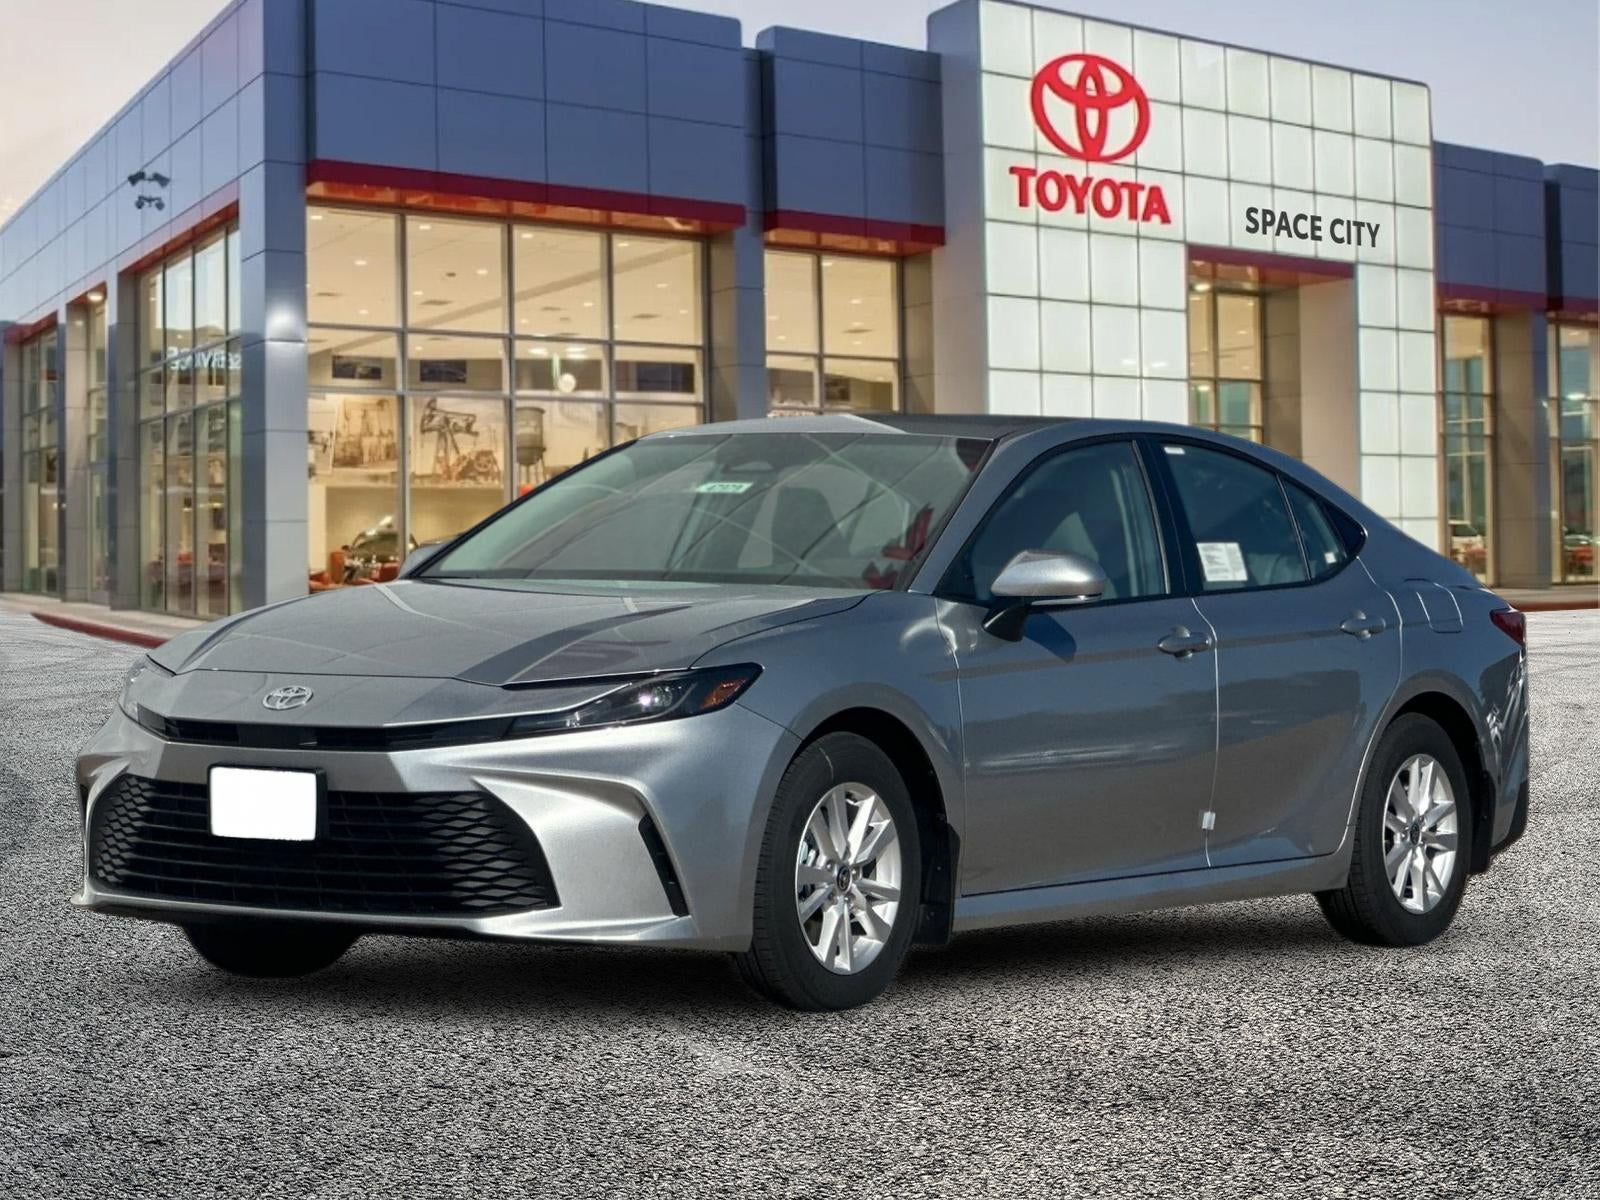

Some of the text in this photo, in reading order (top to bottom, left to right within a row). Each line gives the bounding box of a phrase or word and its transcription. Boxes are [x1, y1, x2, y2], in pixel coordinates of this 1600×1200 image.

[1009, 166, 1171, 224] TOYOTA
[1245, 206, 1381, 248] SPACE CITY
